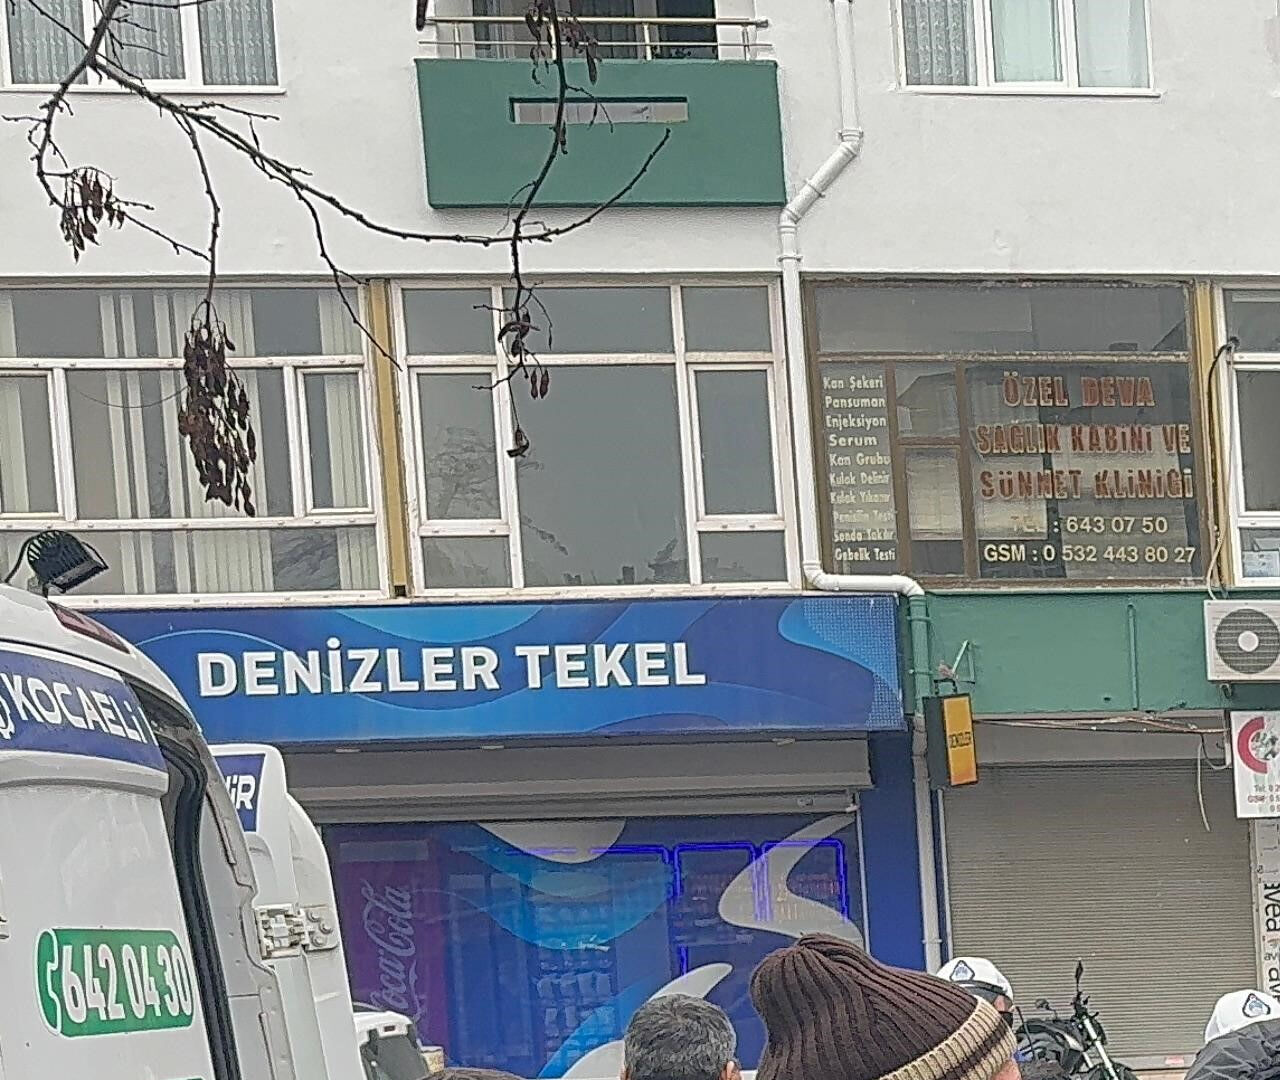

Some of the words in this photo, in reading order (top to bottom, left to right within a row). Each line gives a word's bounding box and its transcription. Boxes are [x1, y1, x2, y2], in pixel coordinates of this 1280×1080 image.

[1003, 371, 1069, 407] ÖZEL
[1080, 376, 1156, 407] DEVA
[825, 395, 886, 408] Pansuman
[825, 413, 886, 430] Enjeksiyon
[829, 434, 877, 446] Serum
[1161, 424, 1191, 454] VE
[980, 469, 1083, 499] SÜNNET
[1066, 517, 1105, 533] 643
[1111, 516, 1135, 533] 07
[1141, 516, 1168, 533] 50
[984, 544, 1026, 562] GSM
[1061, 545, 1097, 562] 532
[1103, 545, 1139, 562] 443
[1144, 546, 1168, 562] 80
[1174, 547, 1196, 563] 27
[197, 637, 501, 698] DENİZLER
[515, 642, 707, 689] TEKEL
[62, 943, 126, 1023] 642
[122, 943, 162, 1018] 04
[157, 944, 193, 1016] 30
